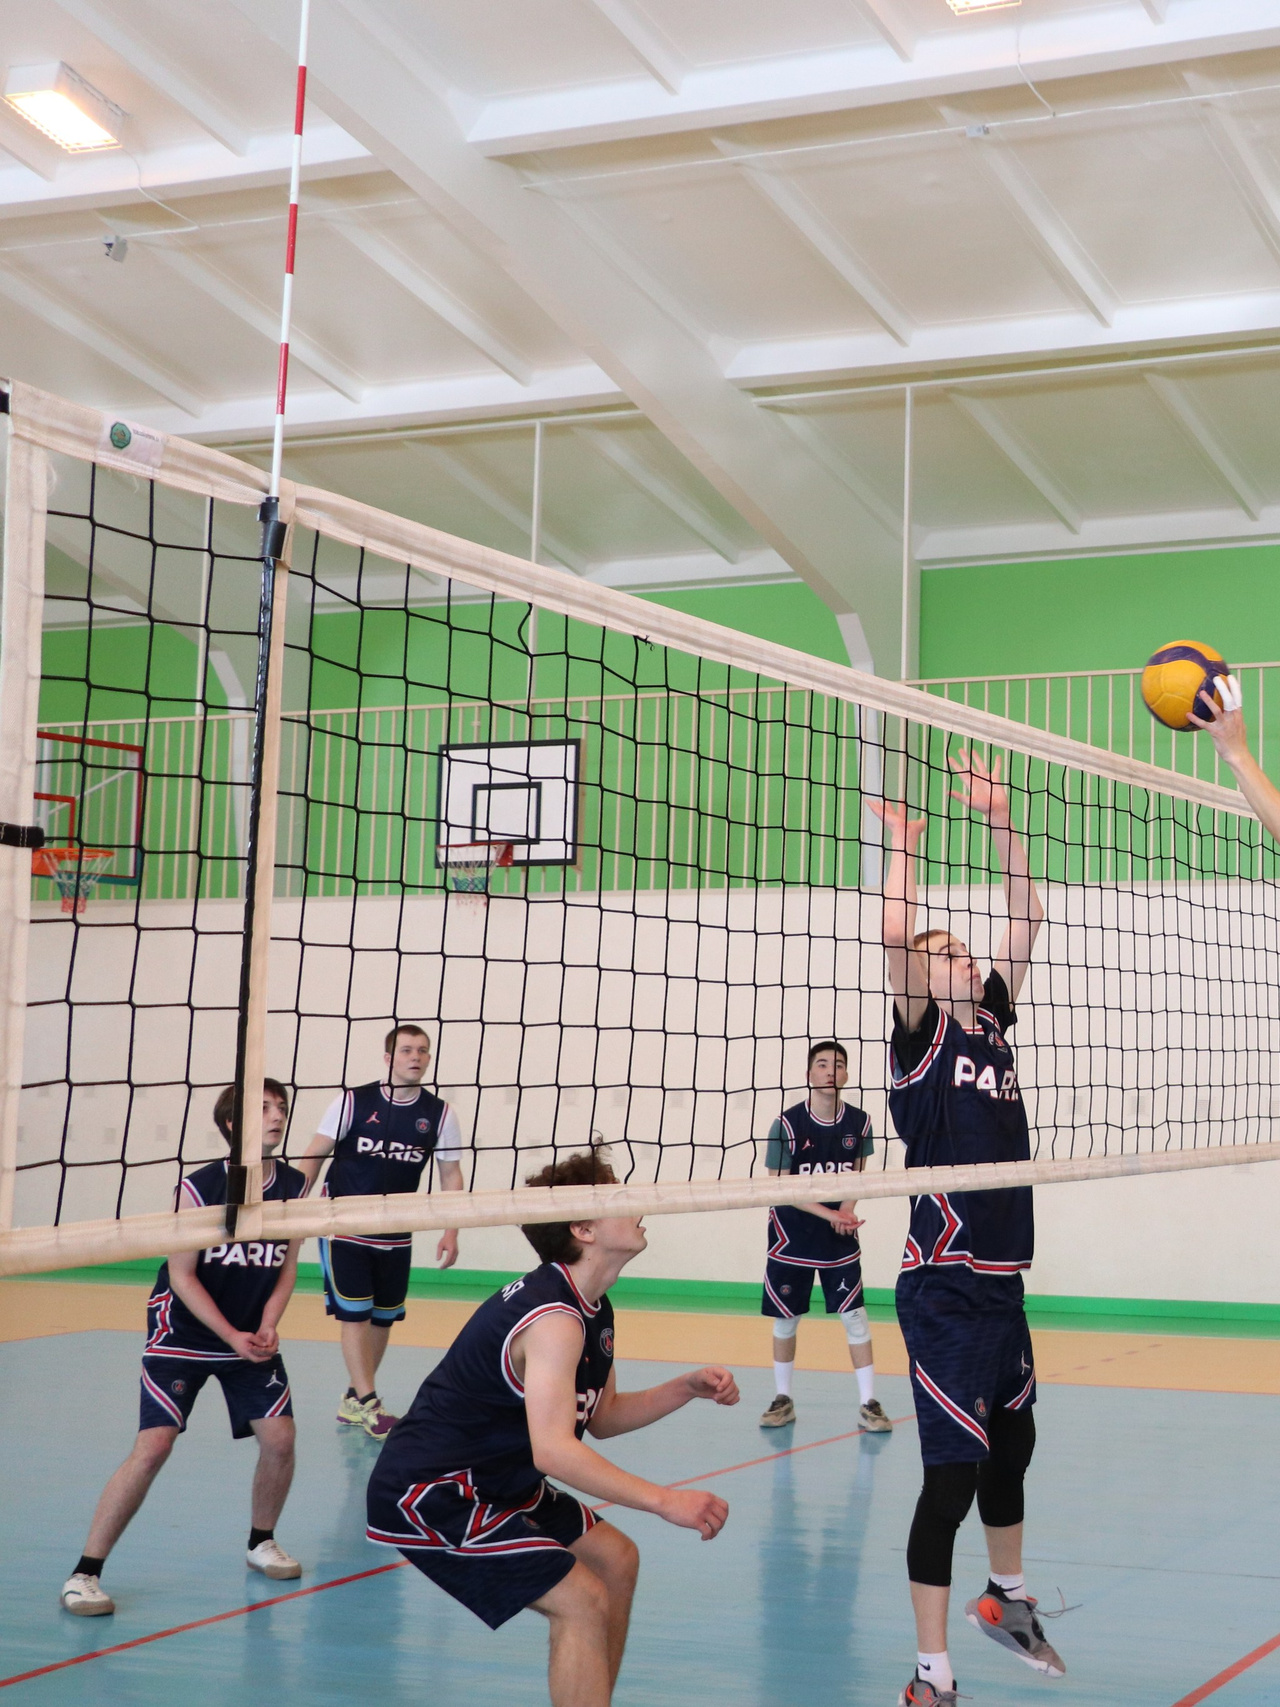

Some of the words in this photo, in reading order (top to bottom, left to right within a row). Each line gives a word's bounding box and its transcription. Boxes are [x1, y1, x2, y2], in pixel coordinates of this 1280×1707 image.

[357, 1136, 424, 1163] PARIS
[799, 1161, 854, 1175] PARIS
[204, 1242, 289, 1268] PARIS
